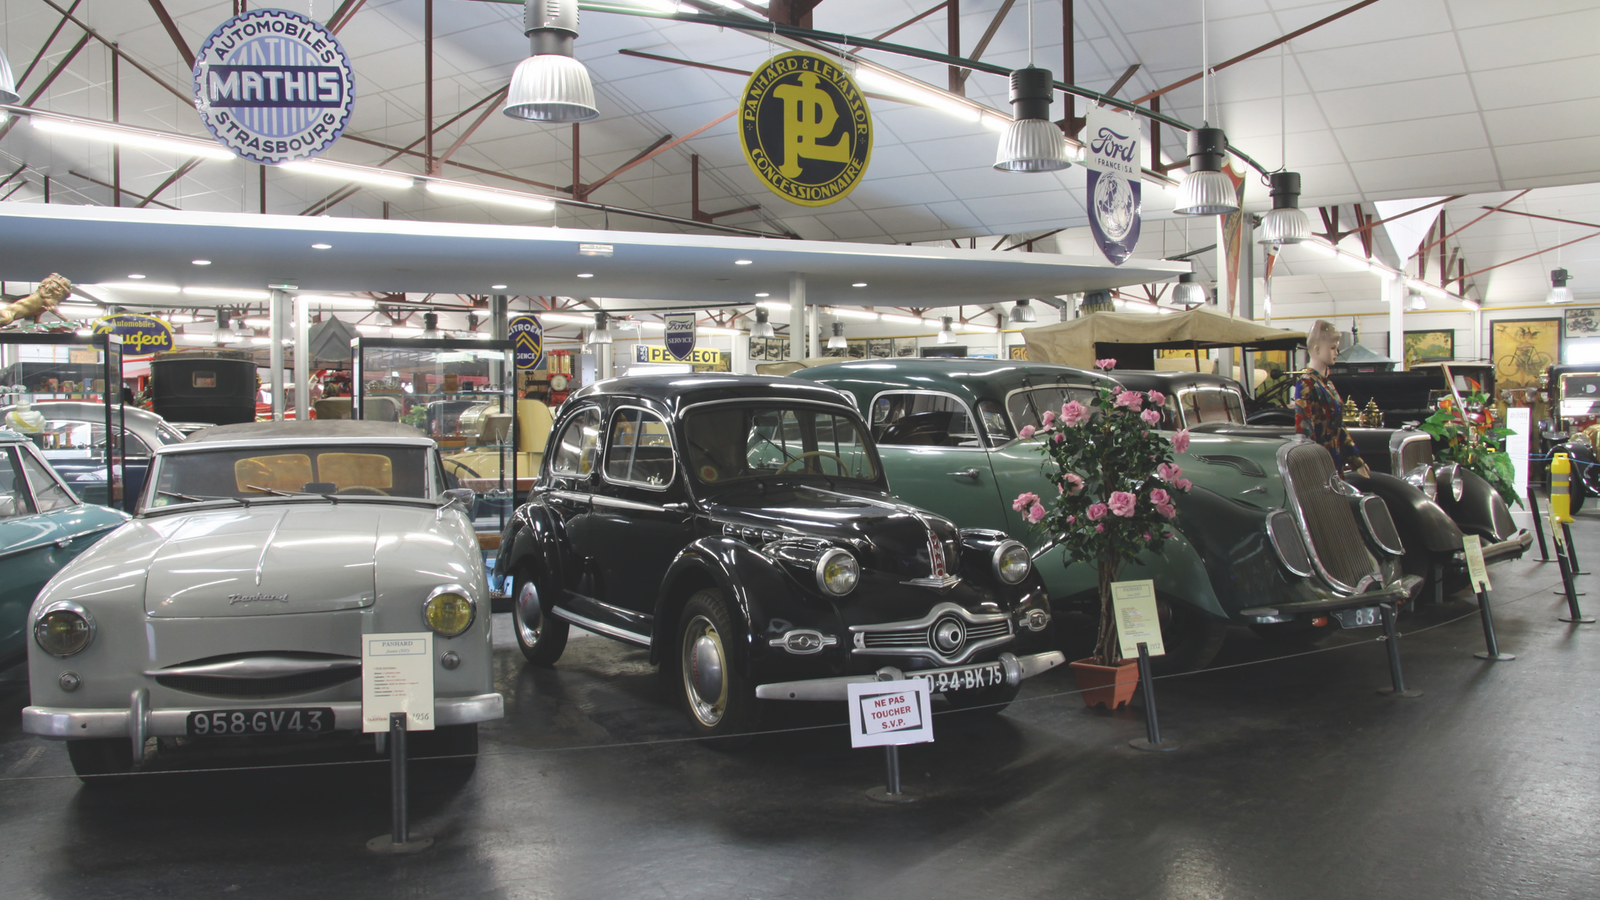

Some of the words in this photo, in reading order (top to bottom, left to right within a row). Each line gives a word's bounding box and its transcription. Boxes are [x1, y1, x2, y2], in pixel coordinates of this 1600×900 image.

[214, 20, 335, 63] AUTOMOBILES
[208, 71, 341, 102] MATHIS
[744, 58, 798, 121] PANHARD
[802, 58, 809, 70] &
[813, 60, 868, 135] LEVASSOR
[215, 111, 336, 153] STRASBOURG
[1090, 127, 1136, 163] Ford
[1098, 157, 1121, 171] FRANCE
[751, 148, 863, 200] CONCESSIONNAIRE
[111, 318, 156, 328] Automobiles
[667, 320, 693, 331] Ford
[668, 336, 693, 344] SERVICE
[516, 352, 535, 360] GENCE
[652, 348, 718, 363] PEEOT
[228, 592, 289, 605] Panhard
[874, 700, 887, 708] NE
[888, 695, 905, 705] PAS
[871, 706, 911, 720] TOUCHER
[881, 718, 906, 729] S.V.P.
